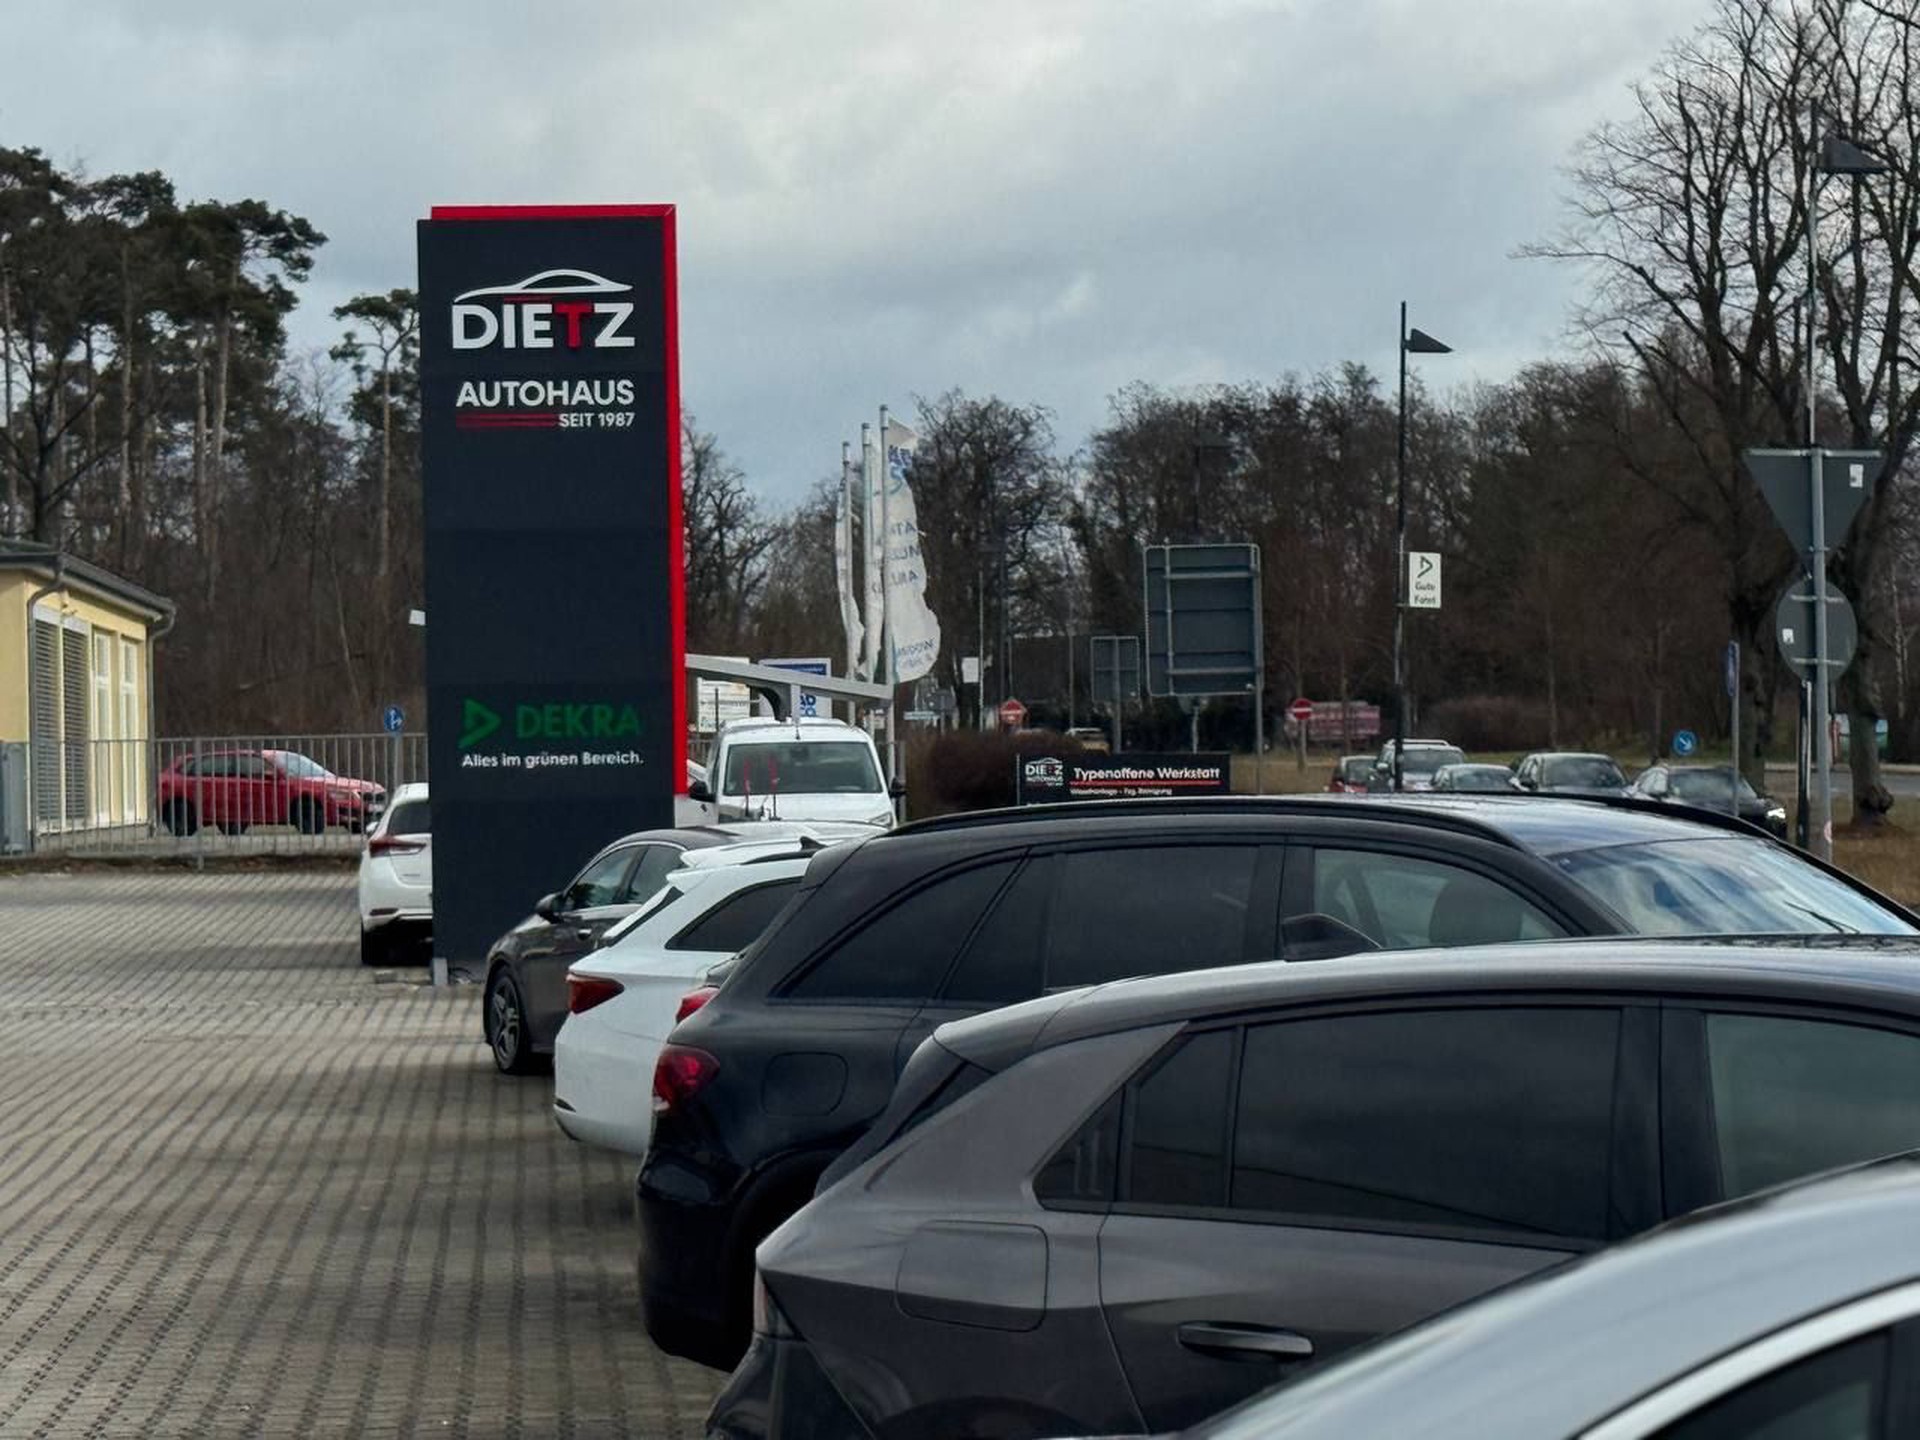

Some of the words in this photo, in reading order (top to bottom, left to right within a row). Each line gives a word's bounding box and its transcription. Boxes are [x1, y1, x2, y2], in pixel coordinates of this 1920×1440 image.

[452, 303, 636, 349] DIETZ
[455, 379, 635, 407] AUTOHAUS
[558, 413, 595, 427] SEIT
[598, 412, 635, 427] 1987
[516, 704, 641, 739] DEKRA
[462, 754, 498, 767] Alles
[501, 753, 521, 767] im
[525, 752, 578, 769] grünen
[582, 751, 644, 766] Bereich.
[1073, 767, 1153, 781] Typenoffene
[1157, 767, 1221, 780] Werkstatt
